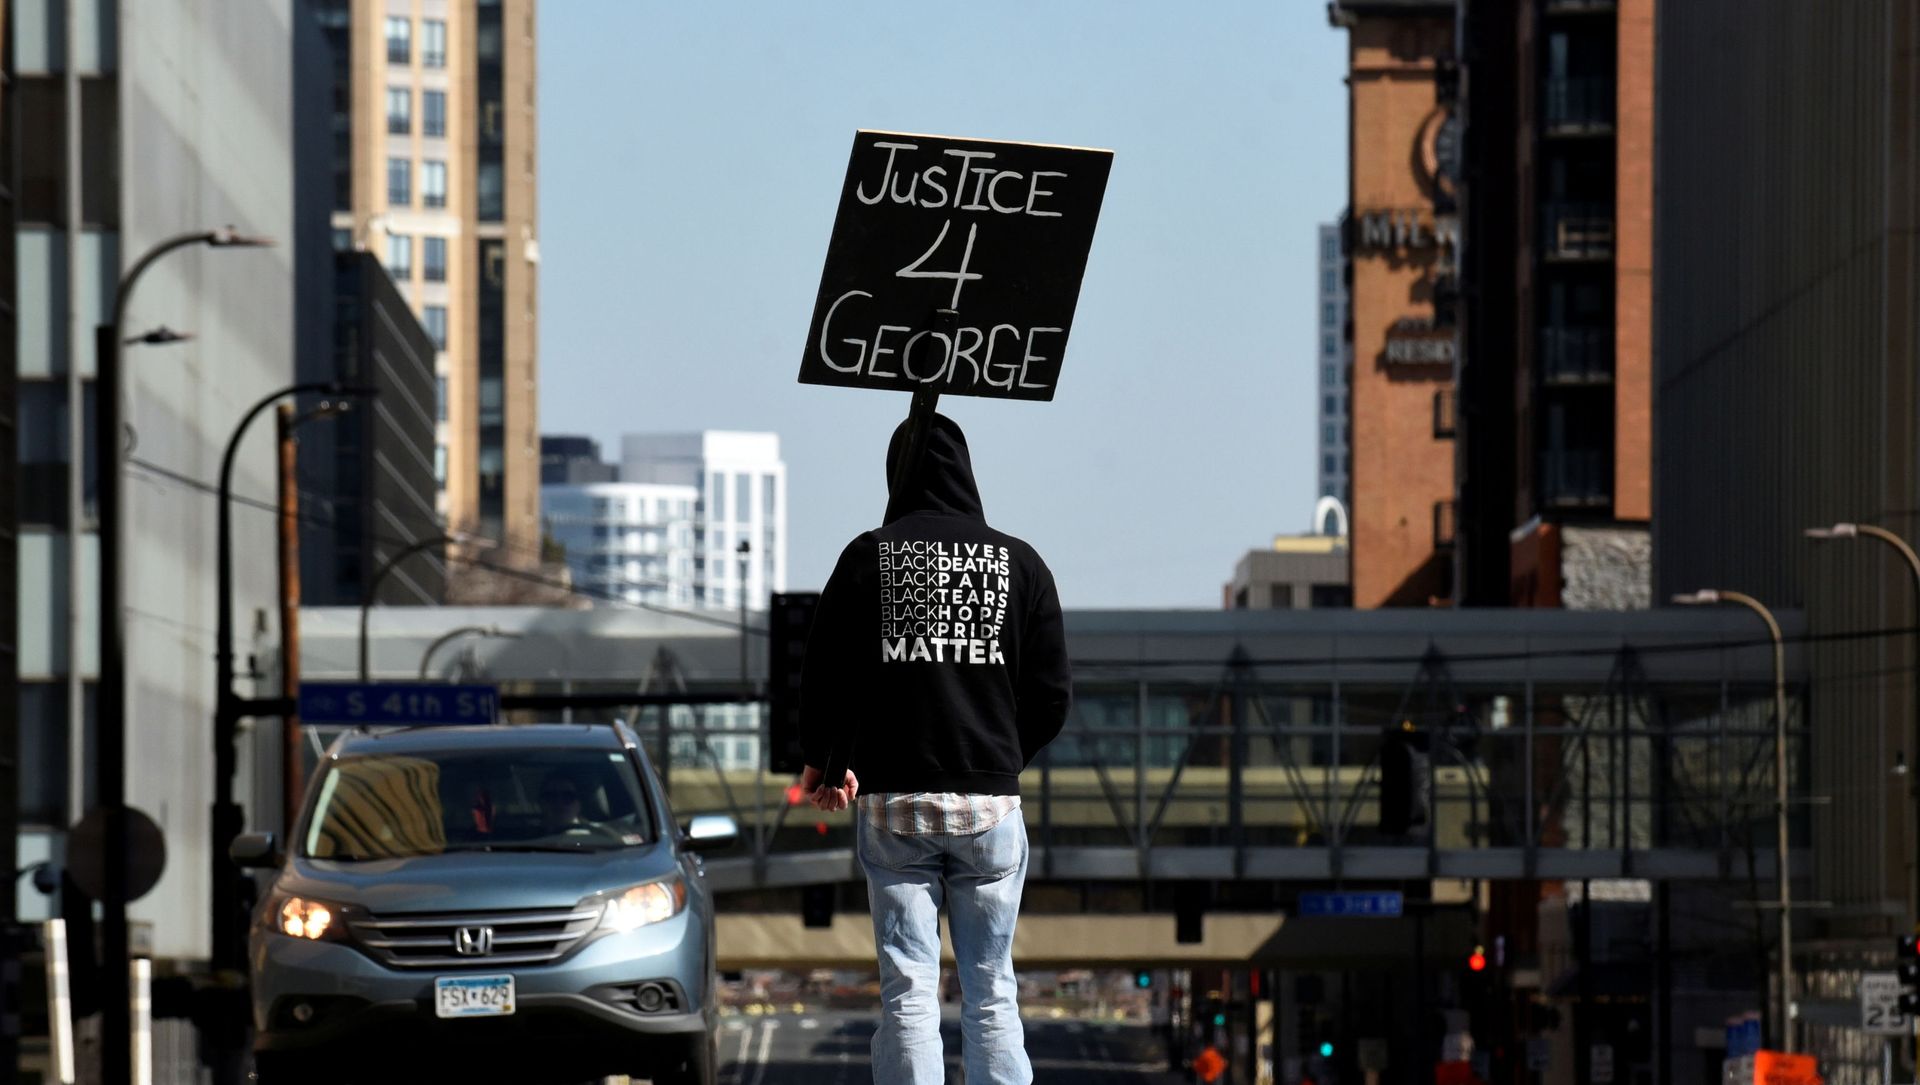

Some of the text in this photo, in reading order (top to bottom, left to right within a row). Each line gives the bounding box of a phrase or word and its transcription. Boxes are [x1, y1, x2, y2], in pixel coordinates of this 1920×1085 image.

[895, 218, 983, 311] 4
[819, 289, 1064, 391] GEORGE
[878, 541, 1009, 561] BLACK LIVES
[879, 555, 1010, 576] BLACK DEATHS
[880, 571, 1009, 592] BLACK PAIN
[880, 587, 1008, 608] BLACK TEARS
[881, 604, 1005, 625] BLACK HOPE
[881, 621, 937, 638] BLACK
[345, 690, 367, 717] S
[380, 690, 443, 717] 4th
[1867, 1005, 1904, 1027] 25
